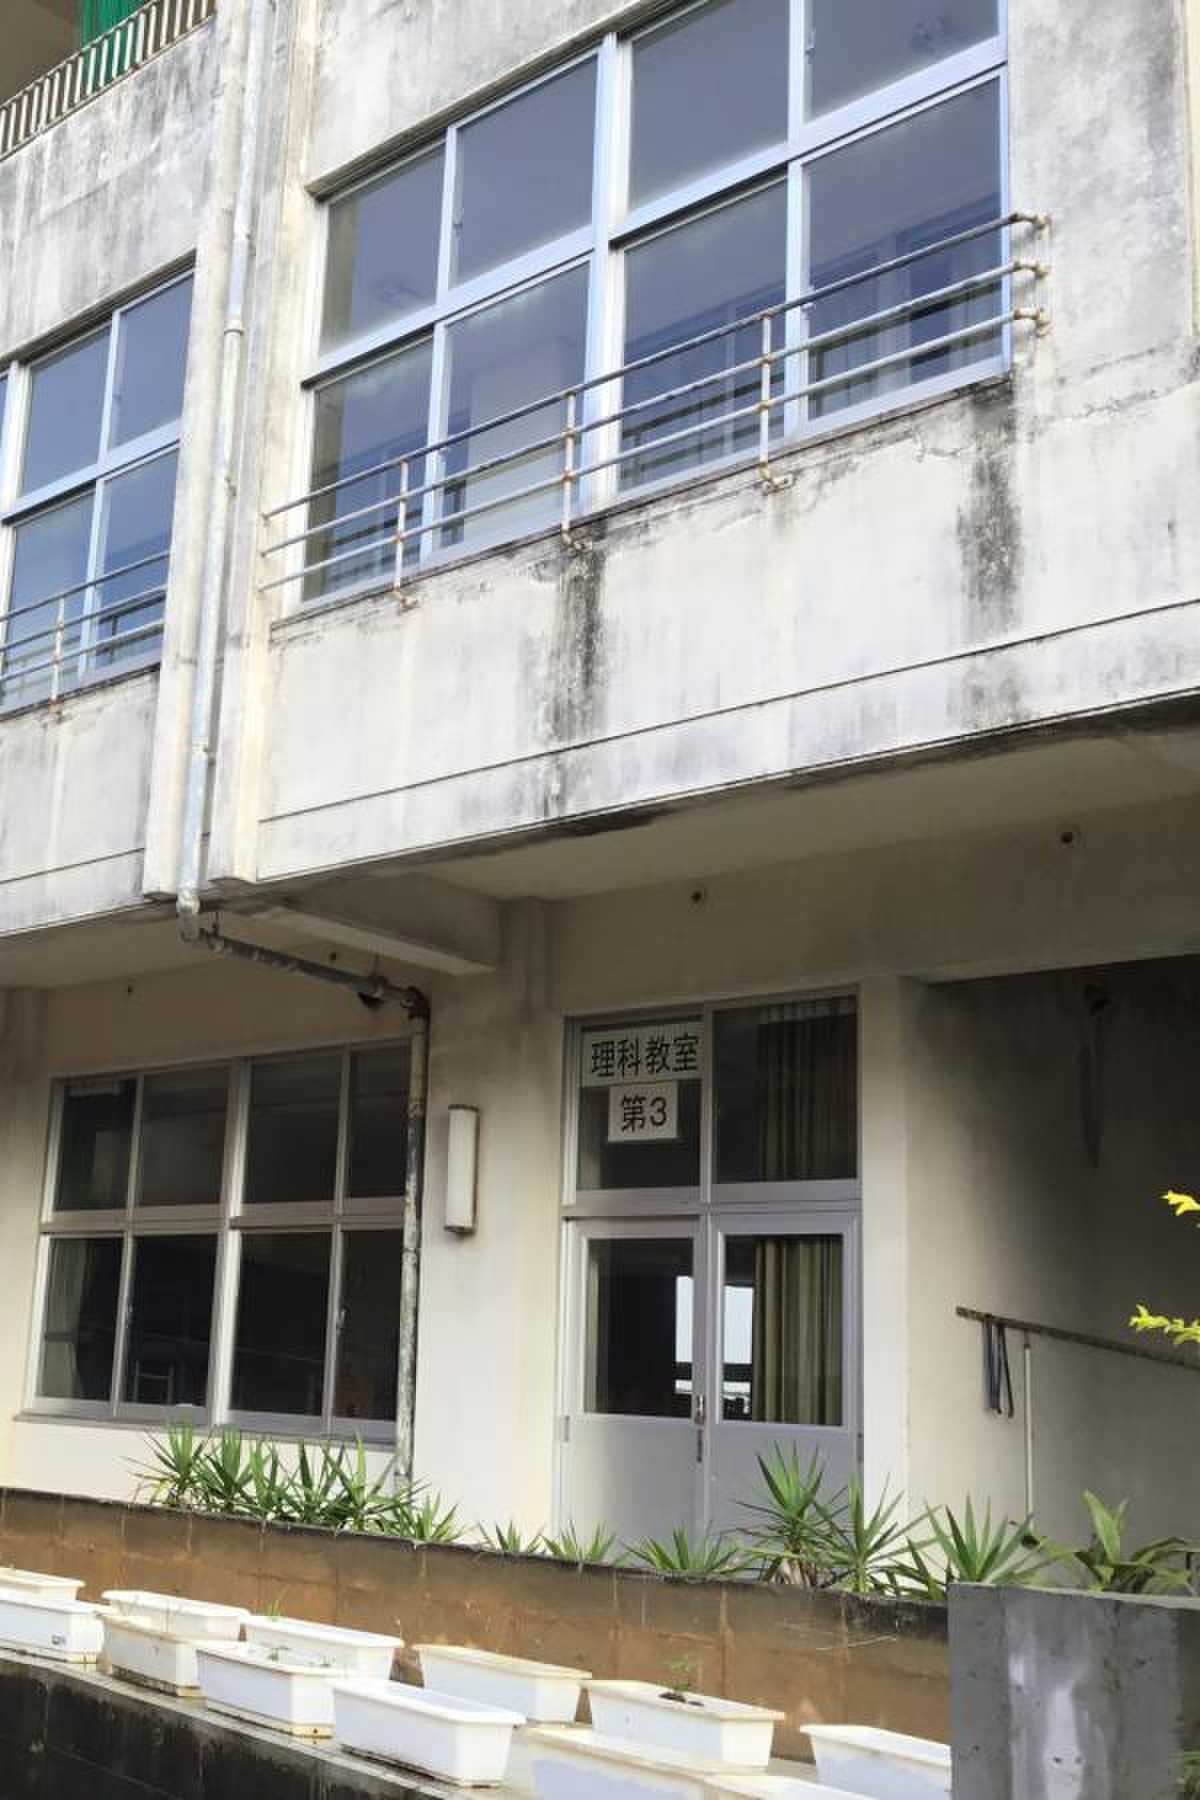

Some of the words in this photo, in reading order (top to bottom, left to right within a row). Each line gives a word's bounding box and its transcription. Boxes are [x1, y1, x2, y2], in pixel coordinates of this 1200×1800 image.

[591, 1033, 699, 1077] 理科教室
[620, 1094, 667, 1132] 第3
